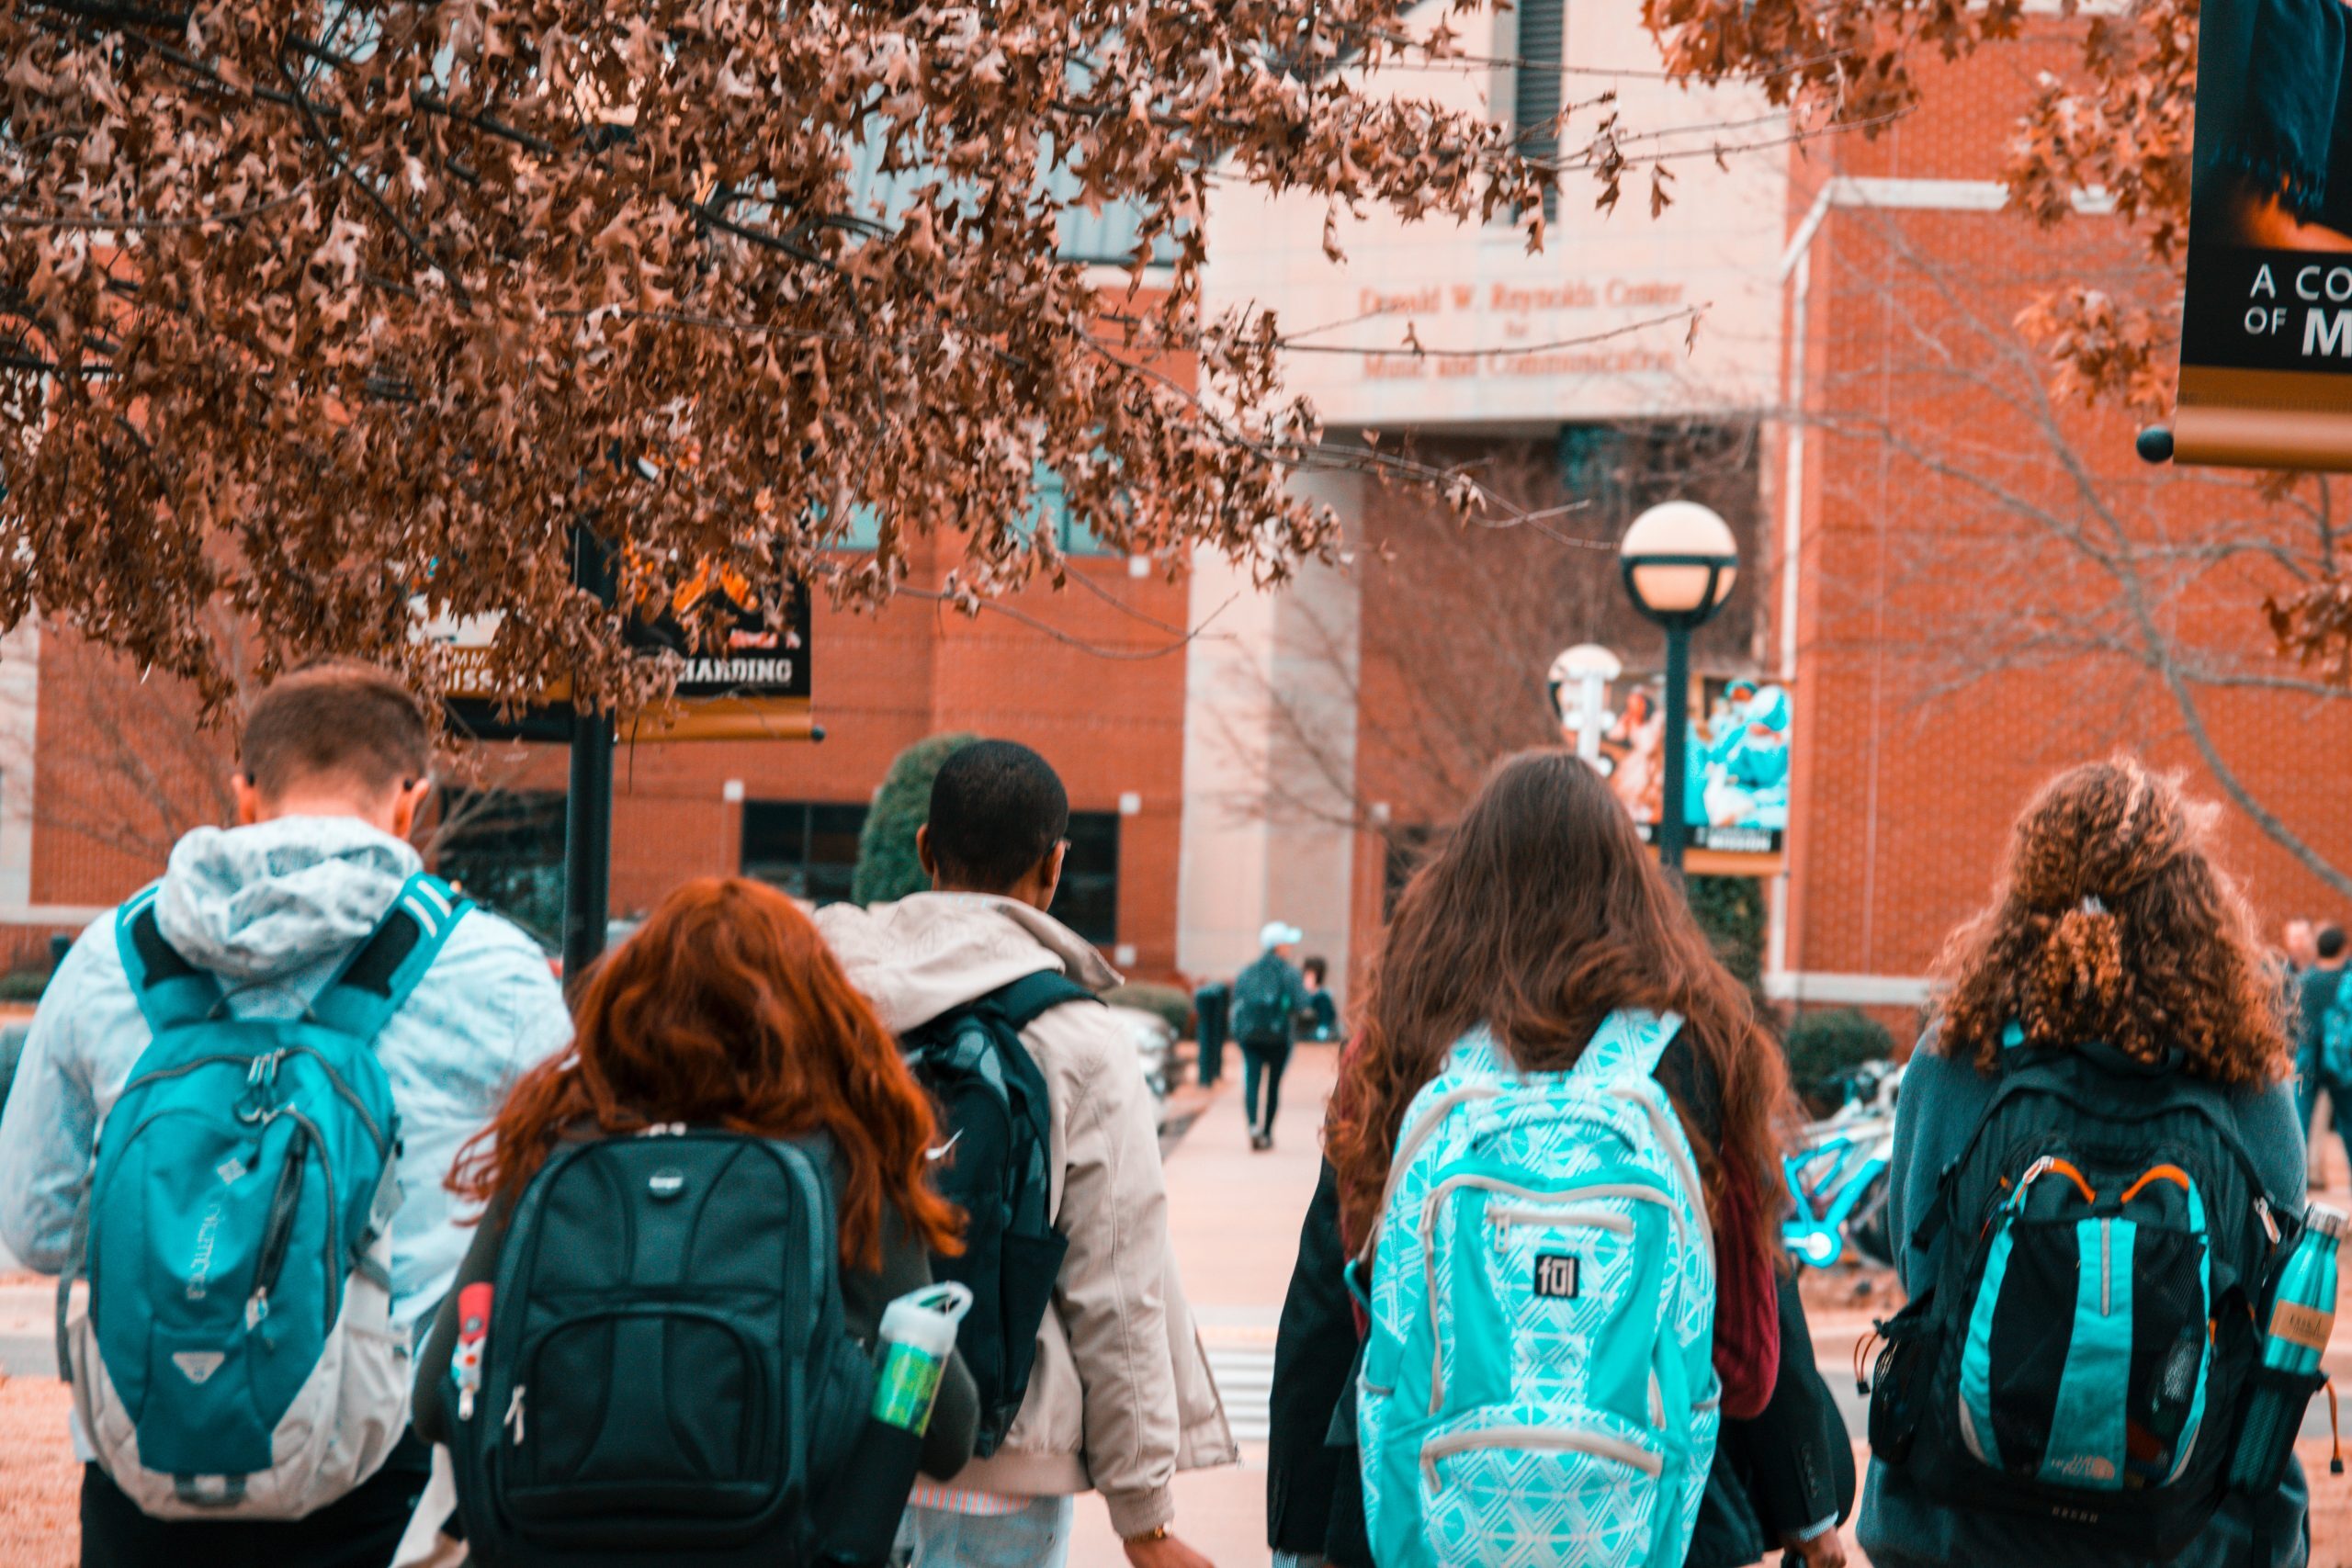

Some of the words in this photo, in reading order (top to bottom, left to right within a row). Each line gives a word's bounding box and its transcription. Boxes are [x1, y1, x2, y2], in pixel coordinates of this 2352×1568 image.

[2249, 263, 2277, 299] A
[2295, 265, 2351, 302] CO
[2244, 306, 2288, 335] OF
[2301, 307, 2351, 357] M
